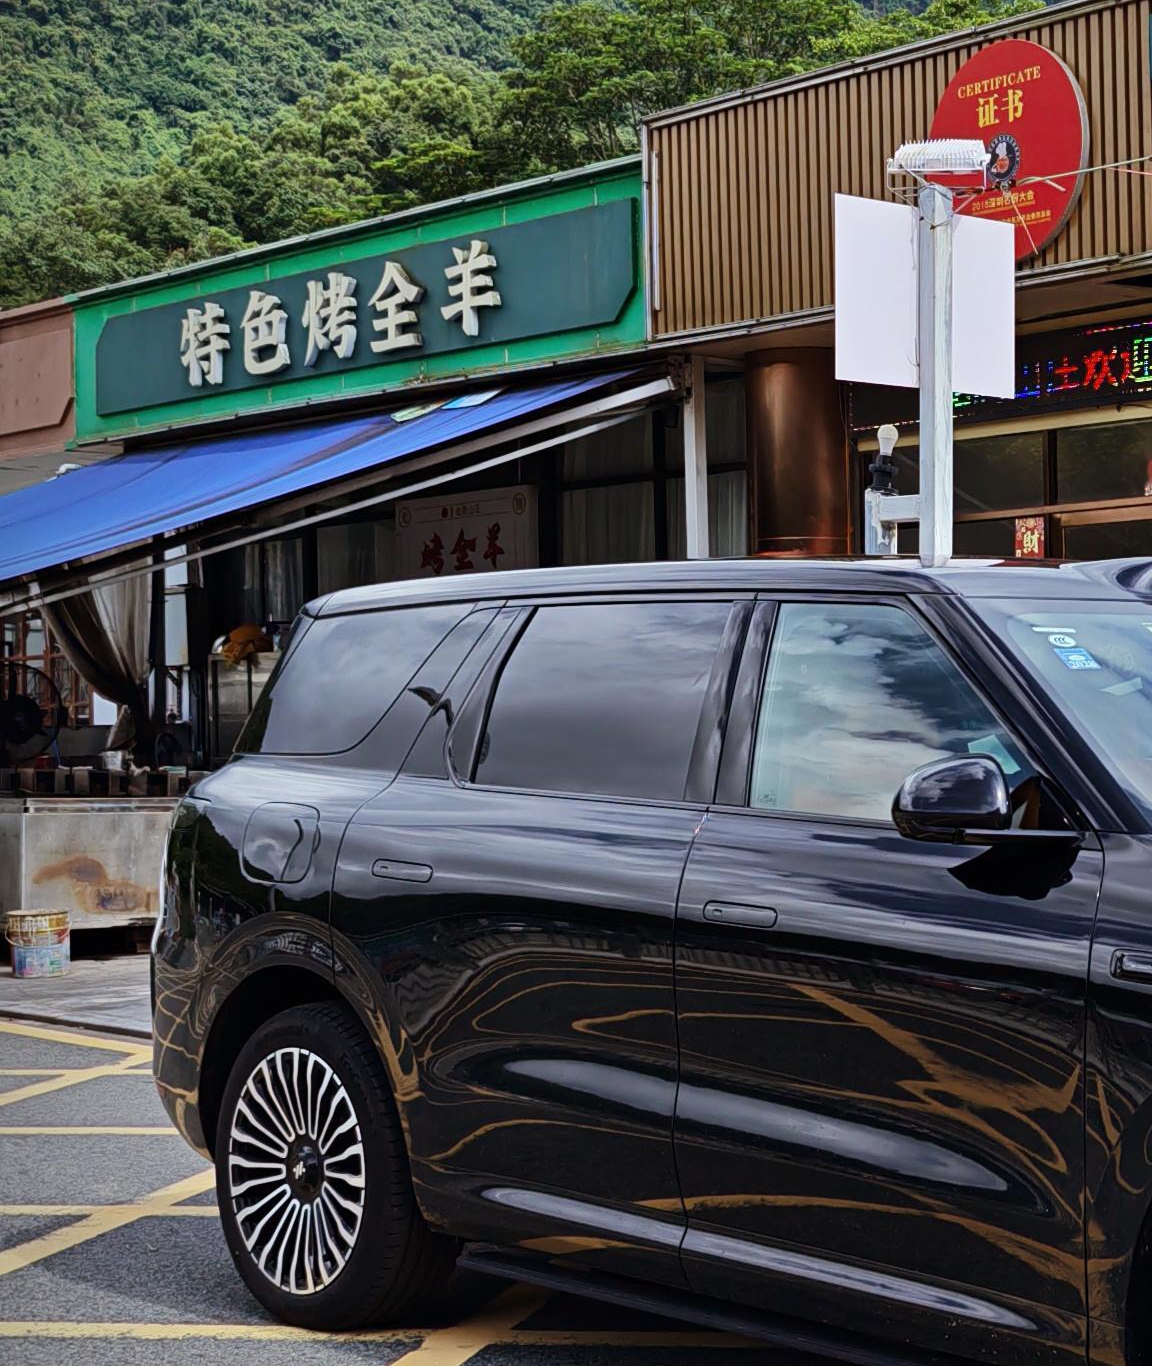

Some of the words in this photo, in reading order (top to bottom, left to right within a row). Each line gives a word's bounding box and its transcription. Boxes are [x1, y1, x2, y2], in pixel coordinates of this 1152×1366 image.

[957, 65, 1042, 99] CERTIFICATE
[976, 89, 1025, 129] 证书
[180, 239, 502, 388] 特色烤全羊
[420, 522, 504, 574] 烤全羊
